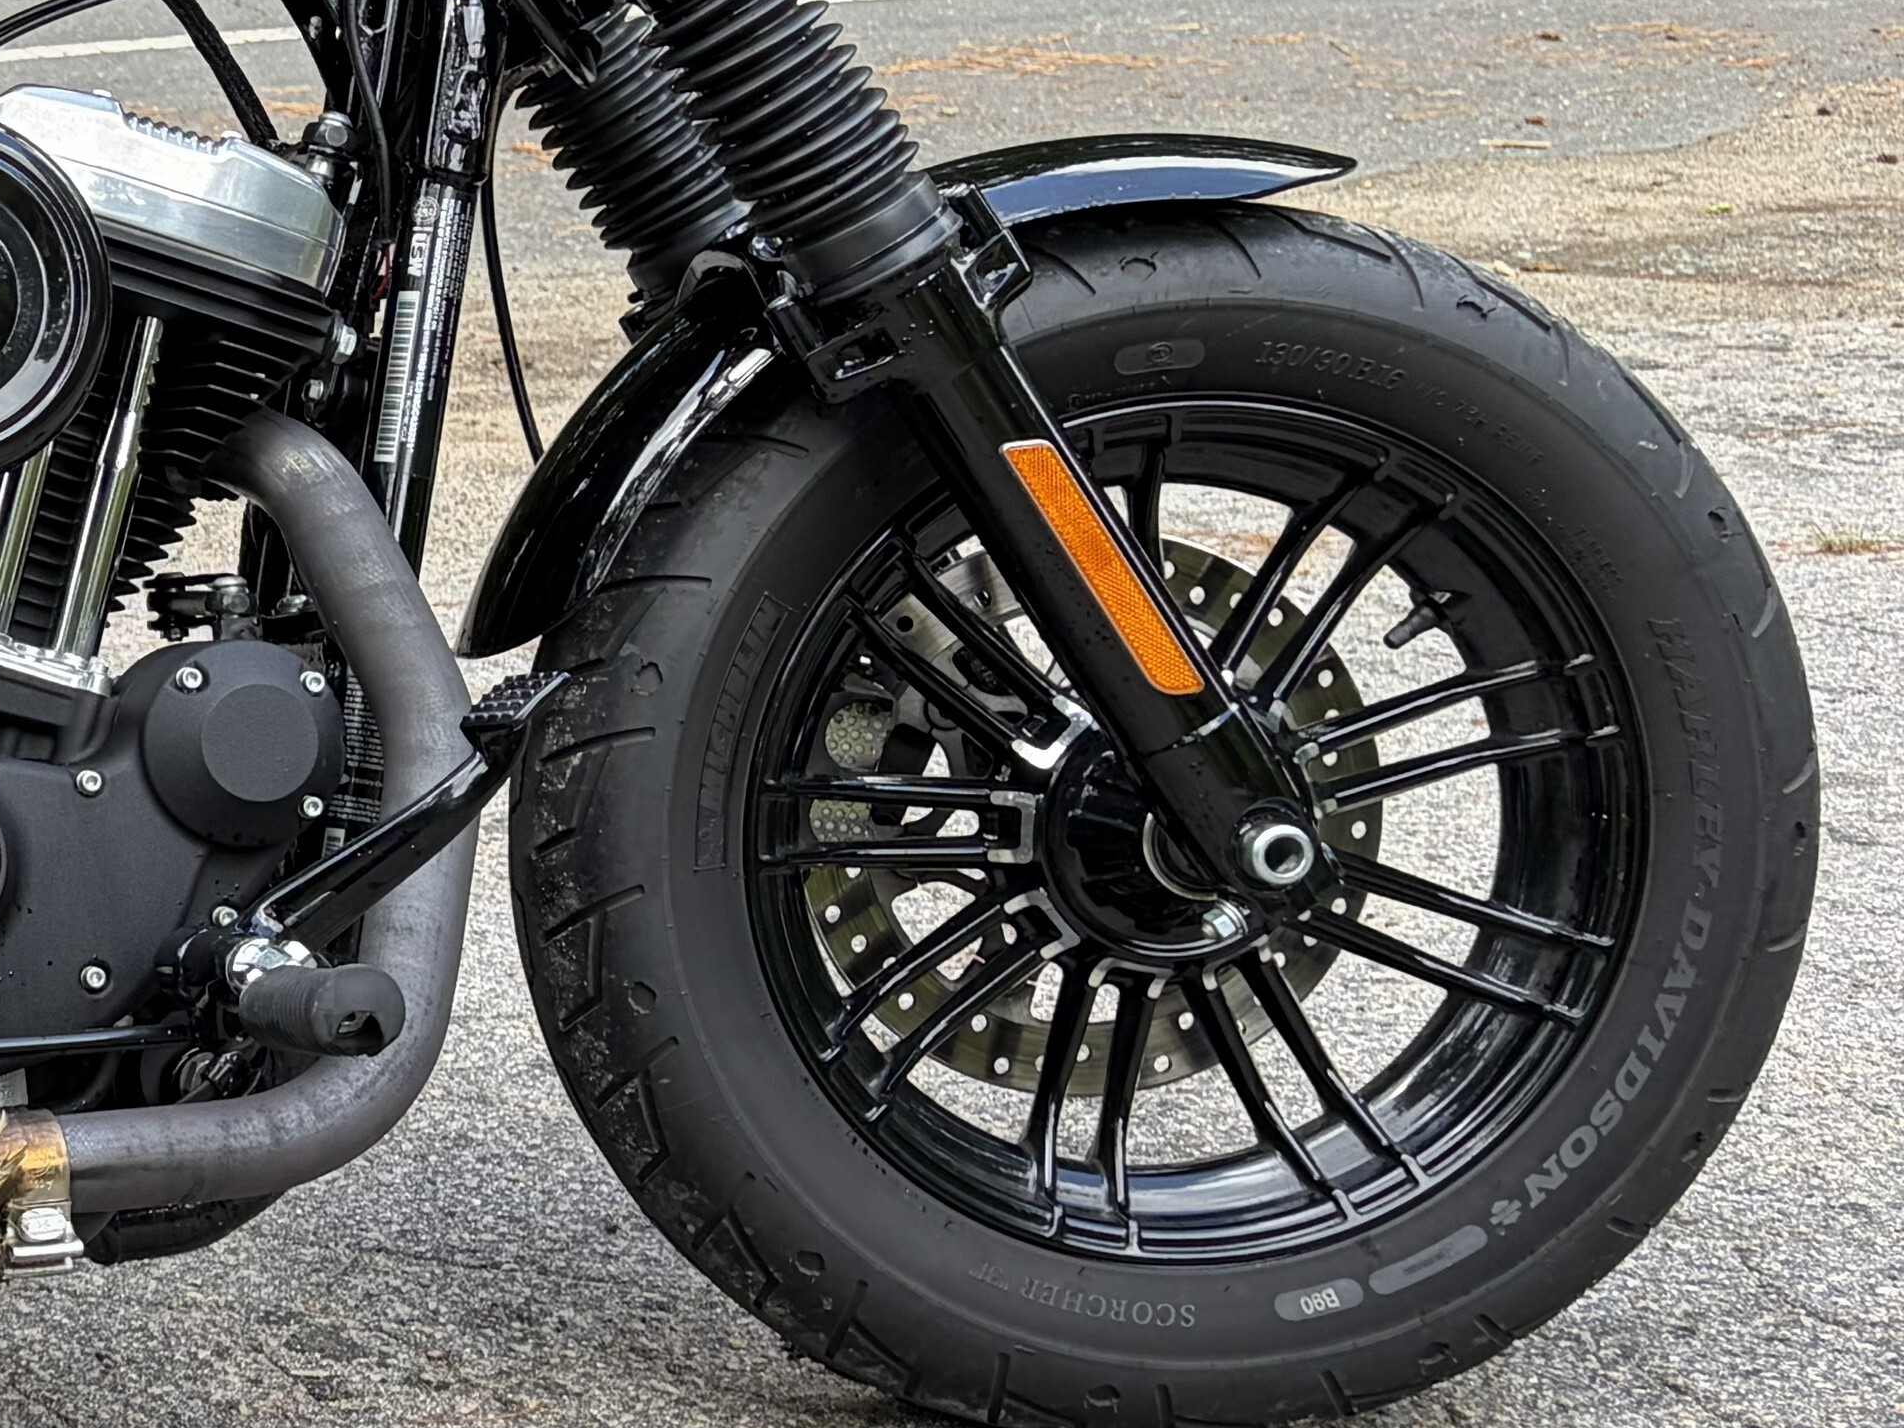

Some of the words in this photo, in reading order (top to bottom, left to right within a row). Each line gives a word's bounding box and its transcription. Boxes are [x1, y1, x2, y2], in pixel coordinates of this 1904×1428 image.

[1523, 617, 1722, 1207] HARLEY-DAVIDSON
[1019, 1275, 1198, 1329] SCORCHER
[1299, 1286, 1341, 1316] B90
